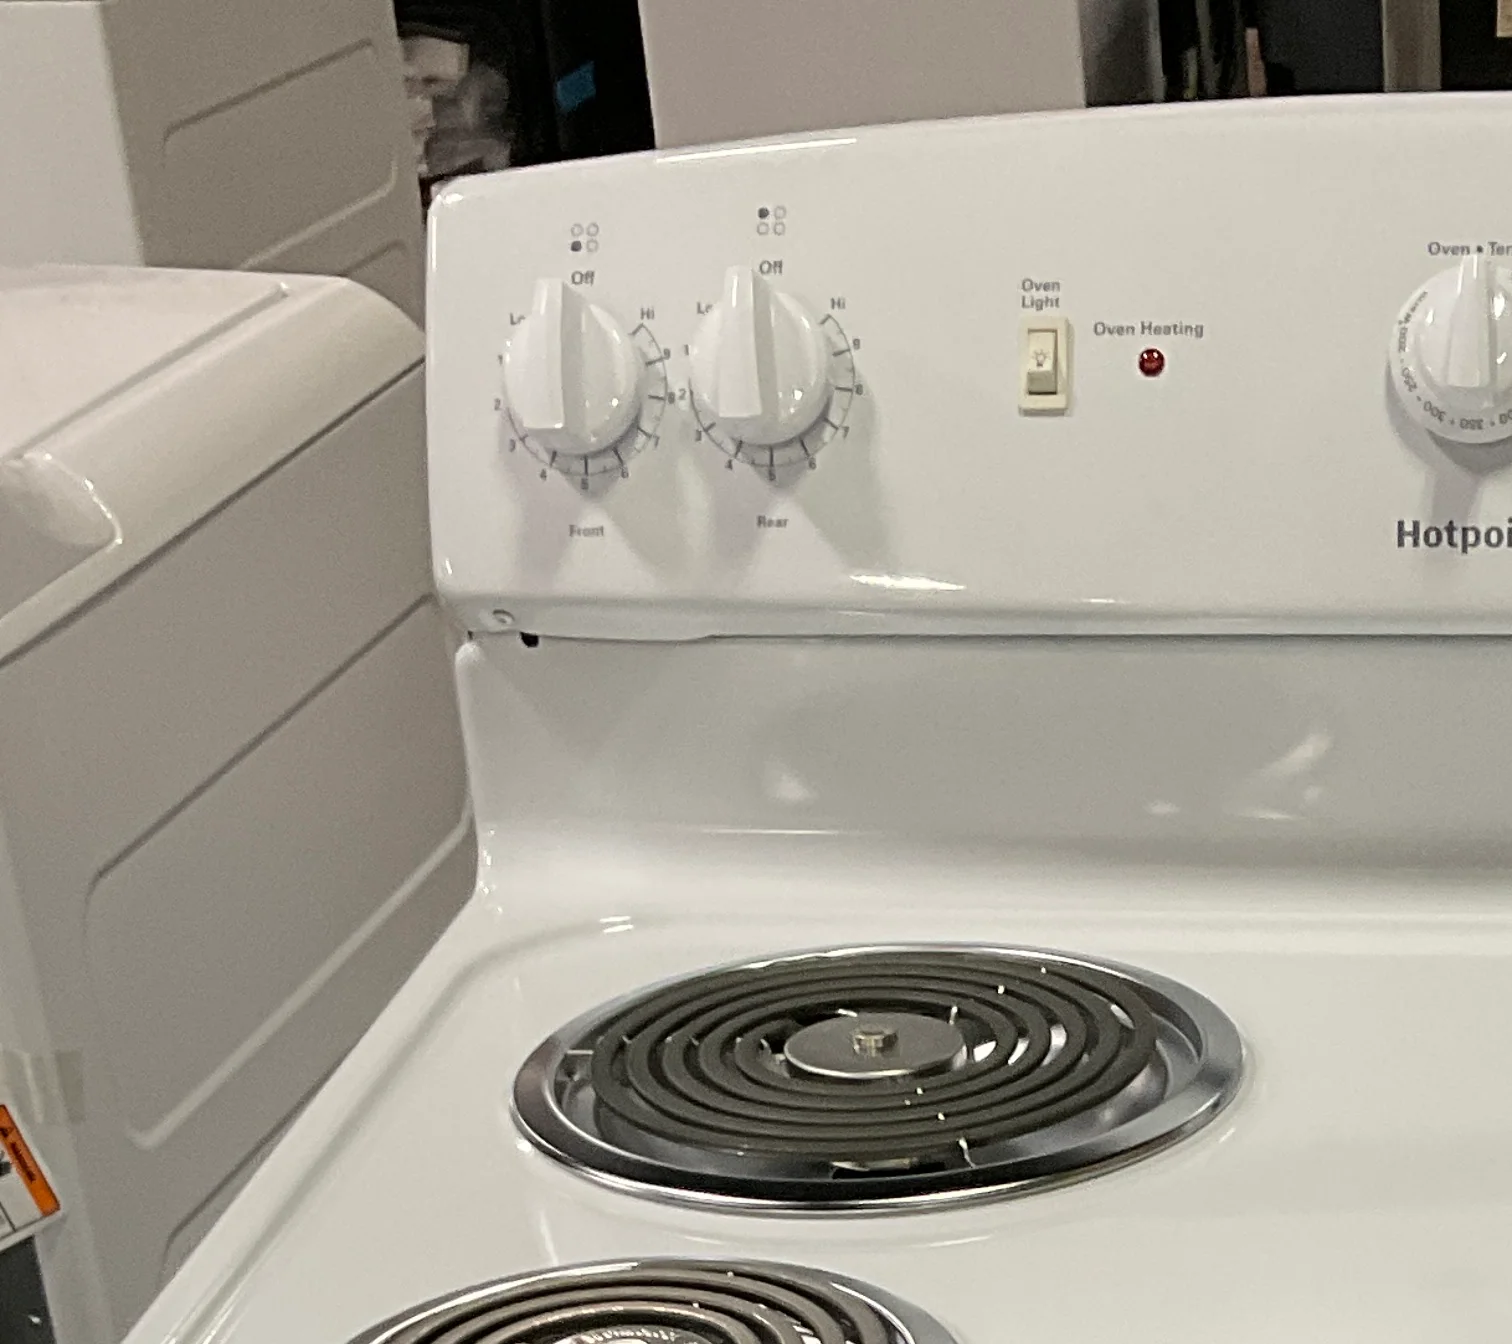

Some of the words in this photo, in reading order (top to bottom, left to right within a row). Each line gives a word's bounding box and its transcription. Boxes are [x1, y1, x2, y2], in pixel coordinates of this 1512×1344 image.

[1427, 241, 1470, 256] Oven
[758, 259, 783, 275] Off
[571, 270, 595, 286] Off
[1021, 277, 1061, 293] Oven
[831, 297, 846, 310] Hi
[1021, 295, 1060, 311] Light
[640, 307, 655, 320] Hi
[1093, 321, 1136, 336] Oven
[1140, 321, 1204, 338] Heating
[1423, 400, 1446, 423] 300
[756, 515, 789, 529] Rear
